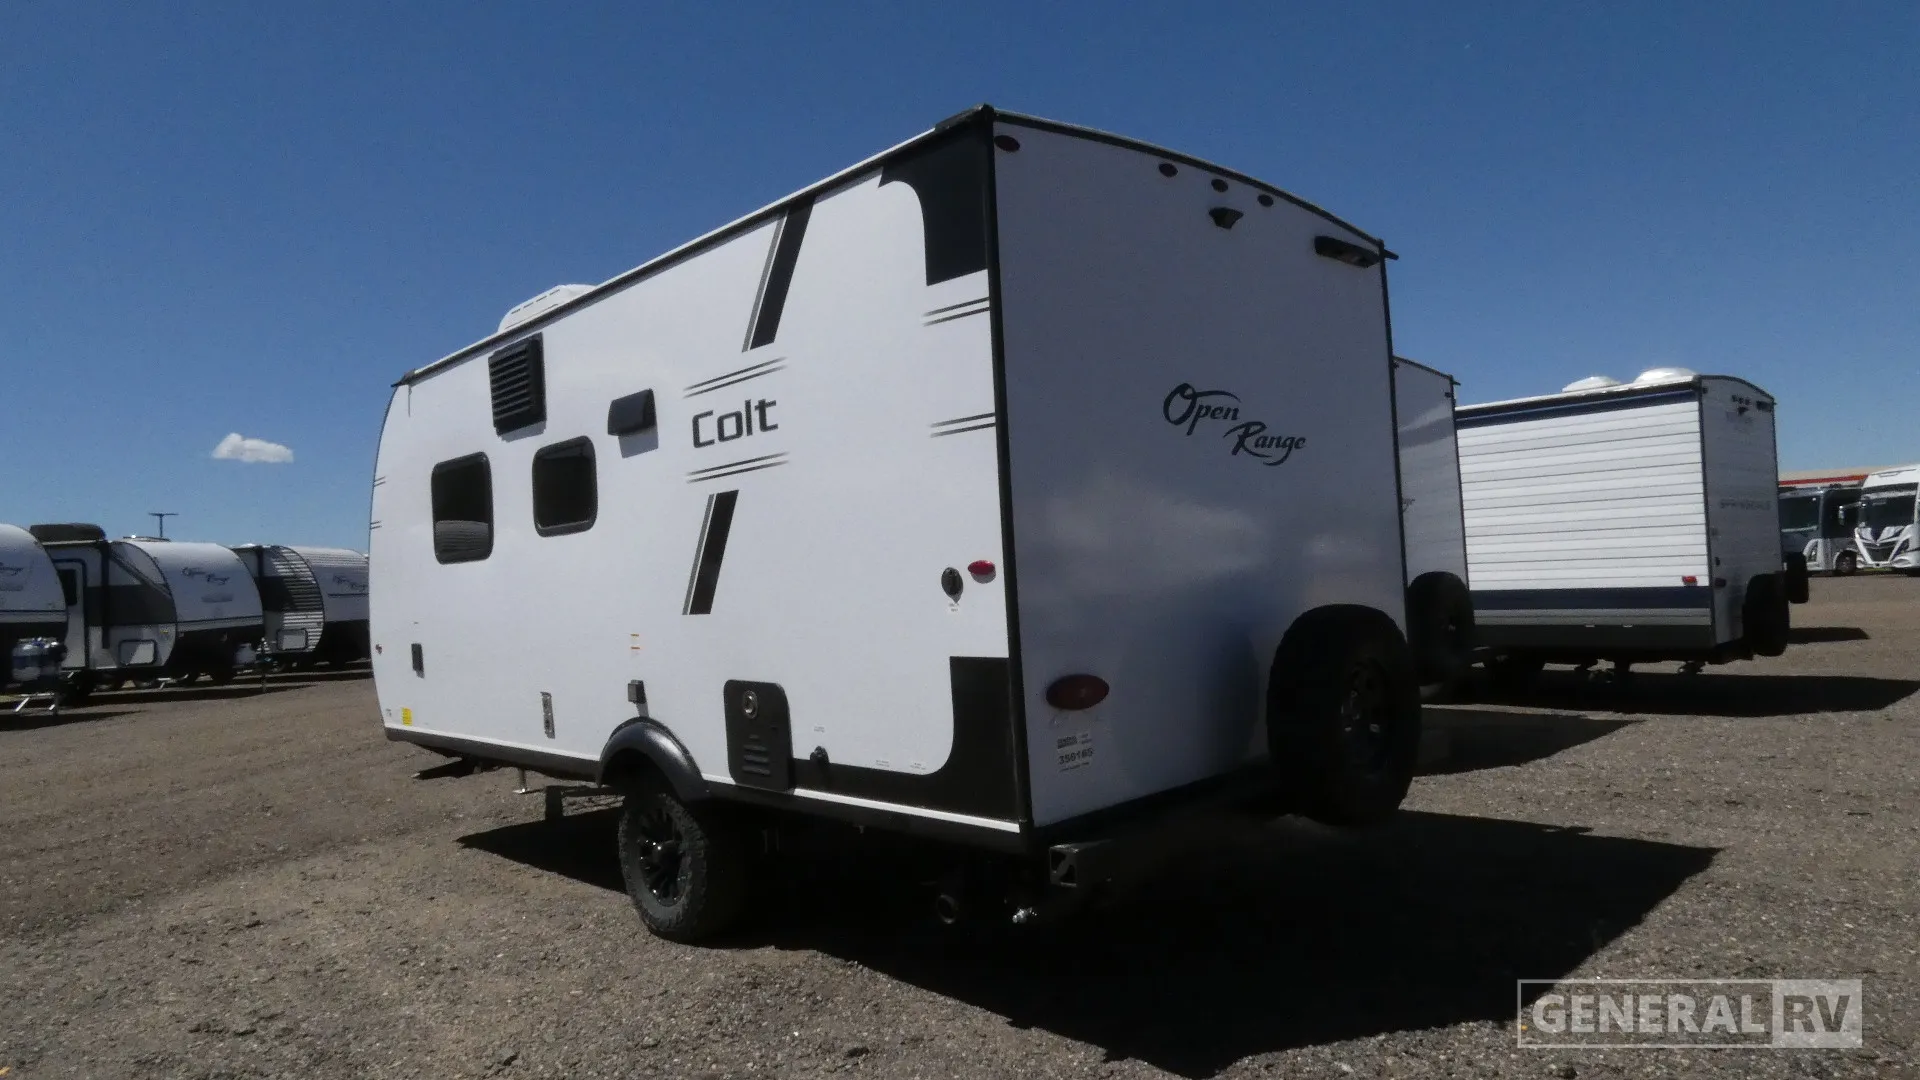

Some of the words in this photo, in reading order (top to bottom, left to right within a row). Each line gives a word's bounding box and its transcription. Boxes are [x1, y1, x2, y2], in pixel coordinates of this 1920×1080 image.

[692, 398, 779, 448] Colt
[1163, 382, 1241, 436] Open
[1223, 421, 1306, 466] Range
